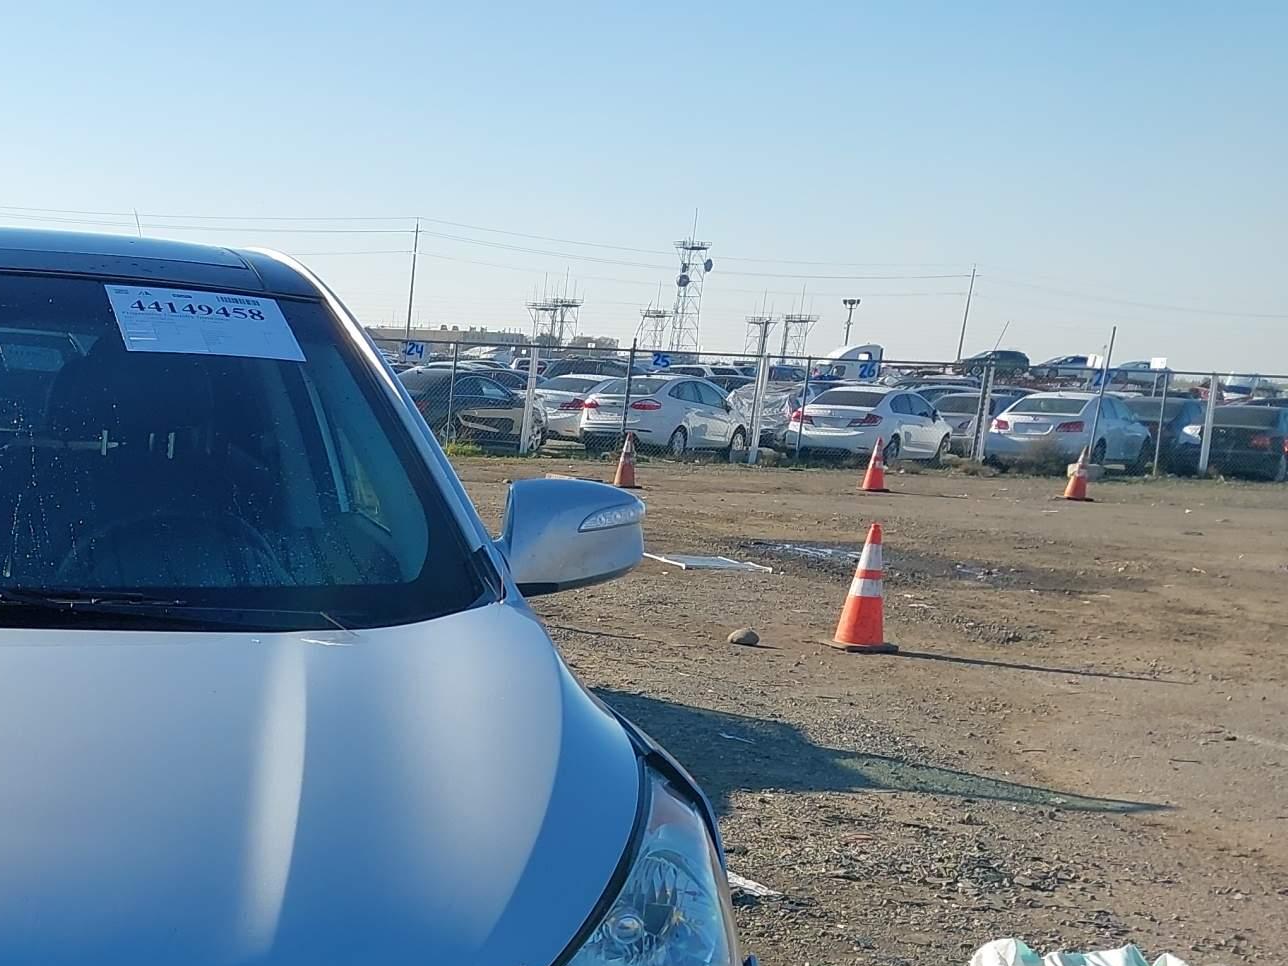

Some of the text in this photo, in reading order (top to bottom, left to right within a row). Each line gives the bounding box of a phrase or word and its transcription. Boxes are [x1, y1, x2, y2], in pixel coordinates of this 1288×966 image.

[130, 299, 265, 321] 44149458
[406, 342, 424, 359] 24
[652, 352, 670, 368] 25
[859, 360, 876, 379] 26
